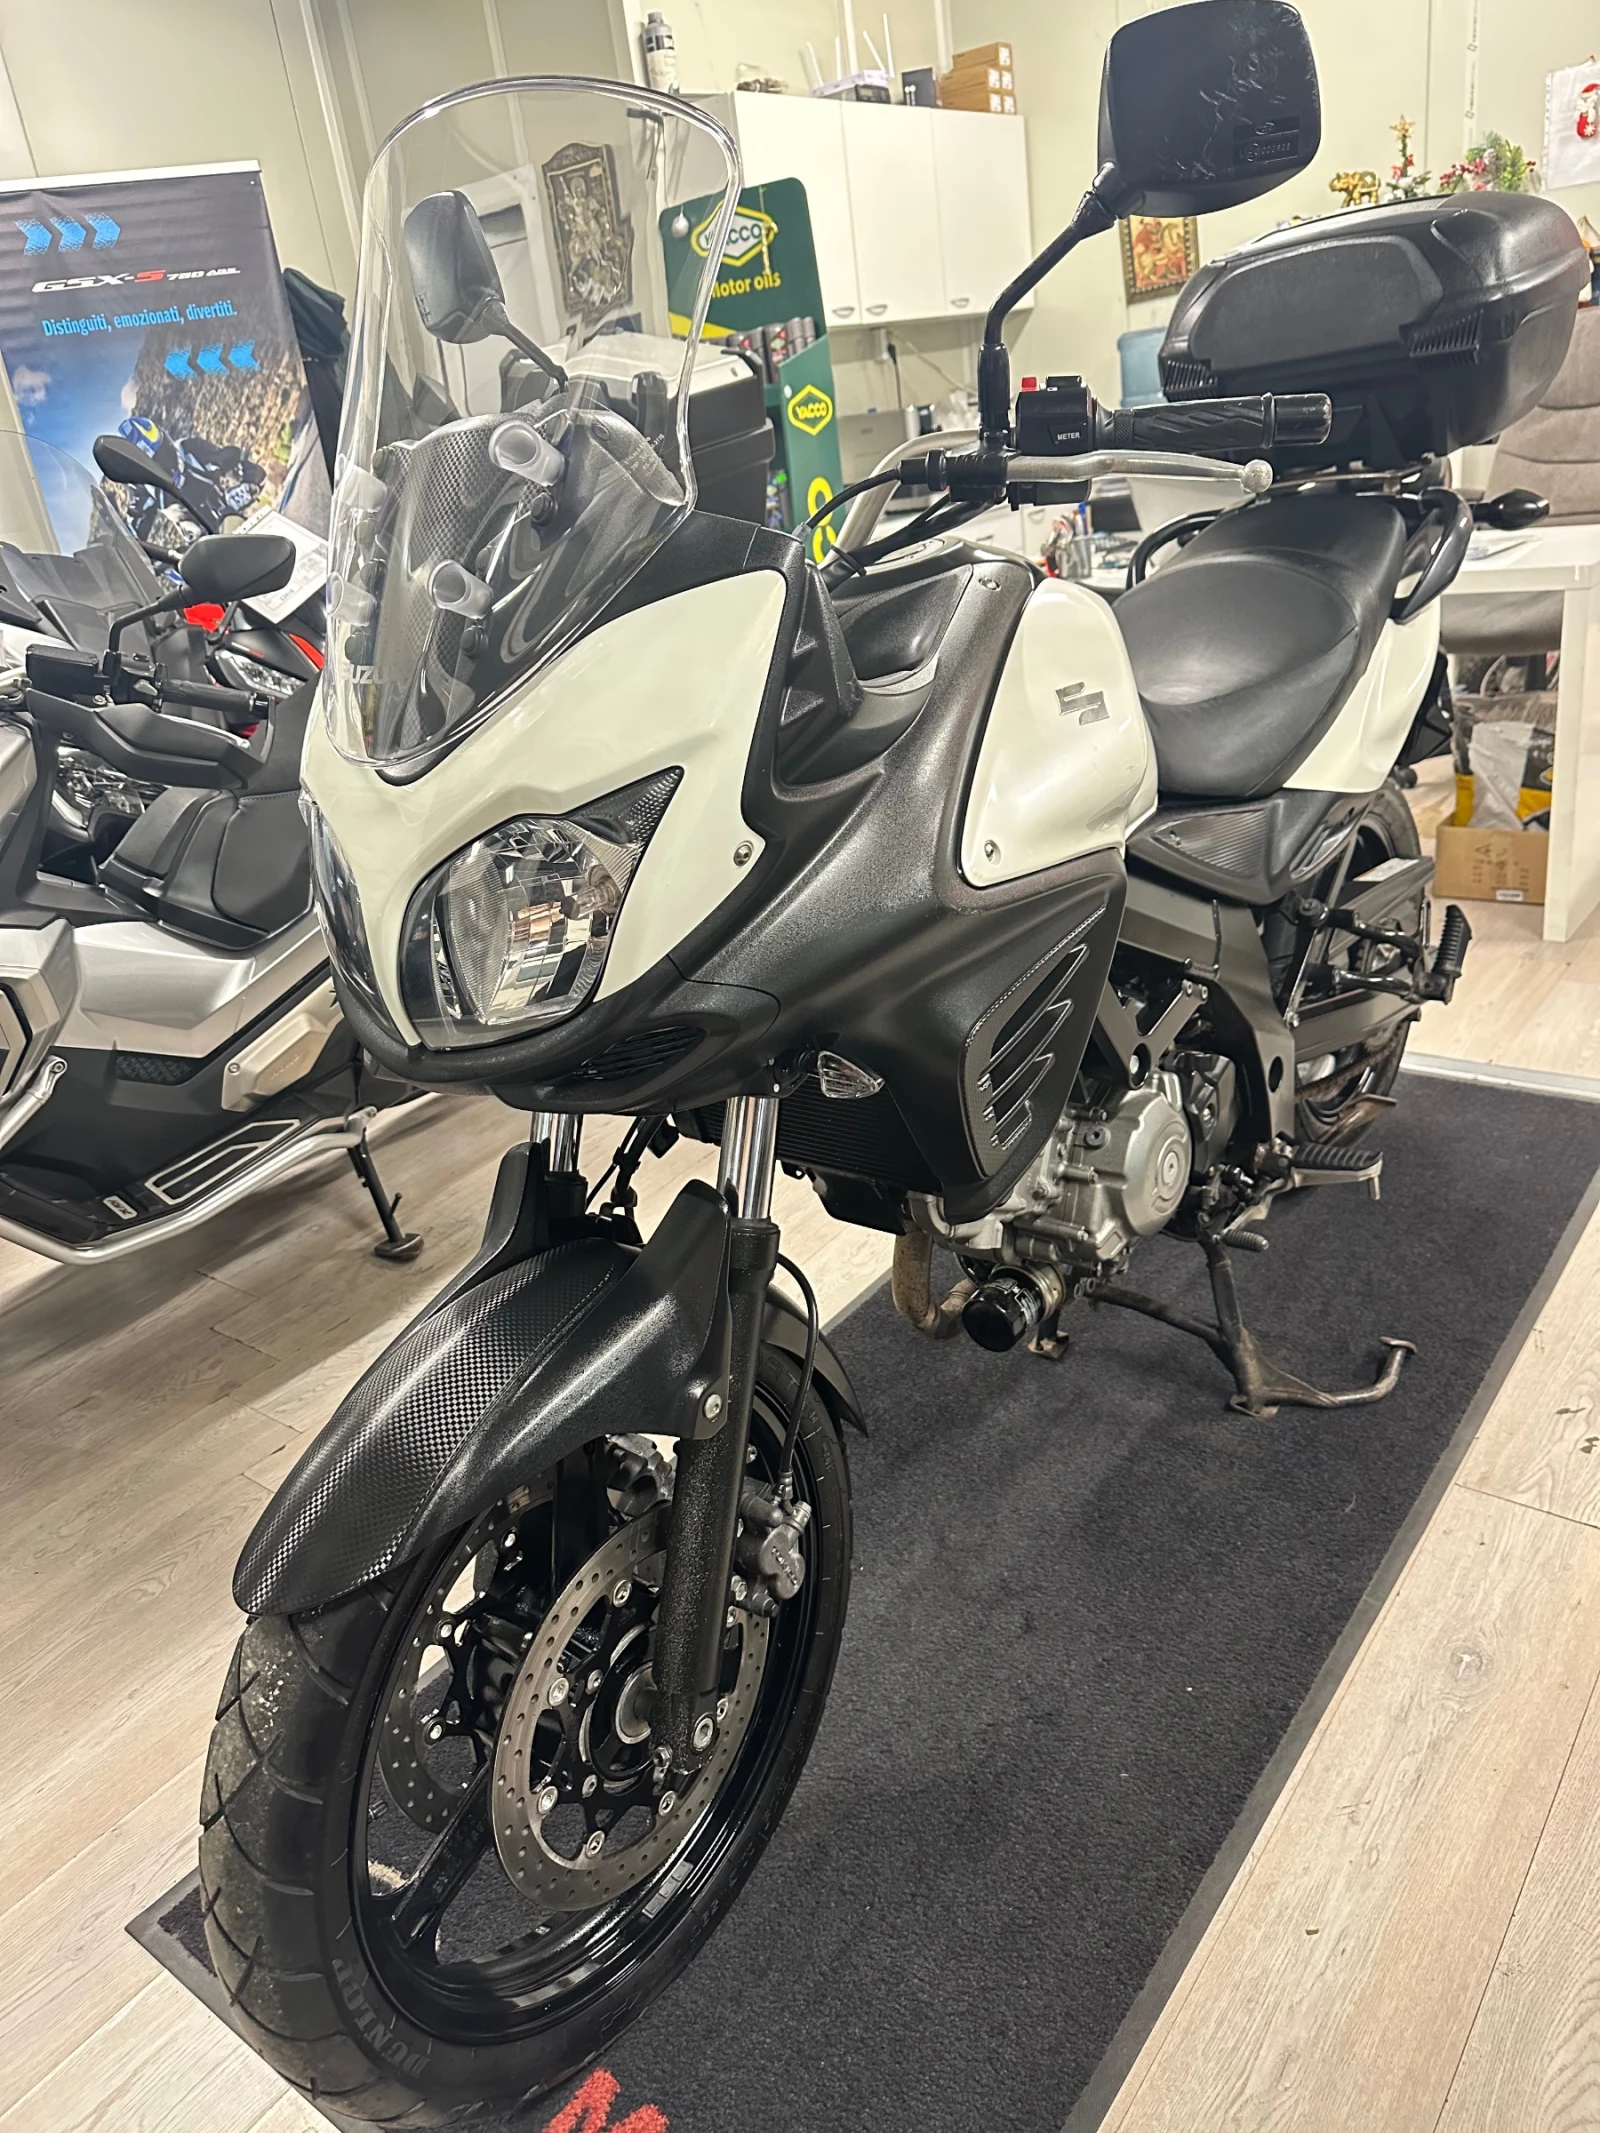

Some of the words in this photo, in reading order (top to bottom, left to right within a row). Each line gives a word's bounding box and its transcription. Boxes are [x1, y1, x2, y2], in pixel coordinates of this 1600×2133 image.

[704, 222, 762, 247] YCCO
[32, 269, 166, 293] GSX-S
[753, 271, 782, 291] oils
[42, 313, 112, 337] Distinguiti,
[113, 304, 185, 330] emozionati,
[186, 300, 238, 320] divertiti.
[795, 401, 828, 420] YACCO
[1056, 431, 1081, 441] METER
[331, 1957, 431, 2078] DUNLOP
